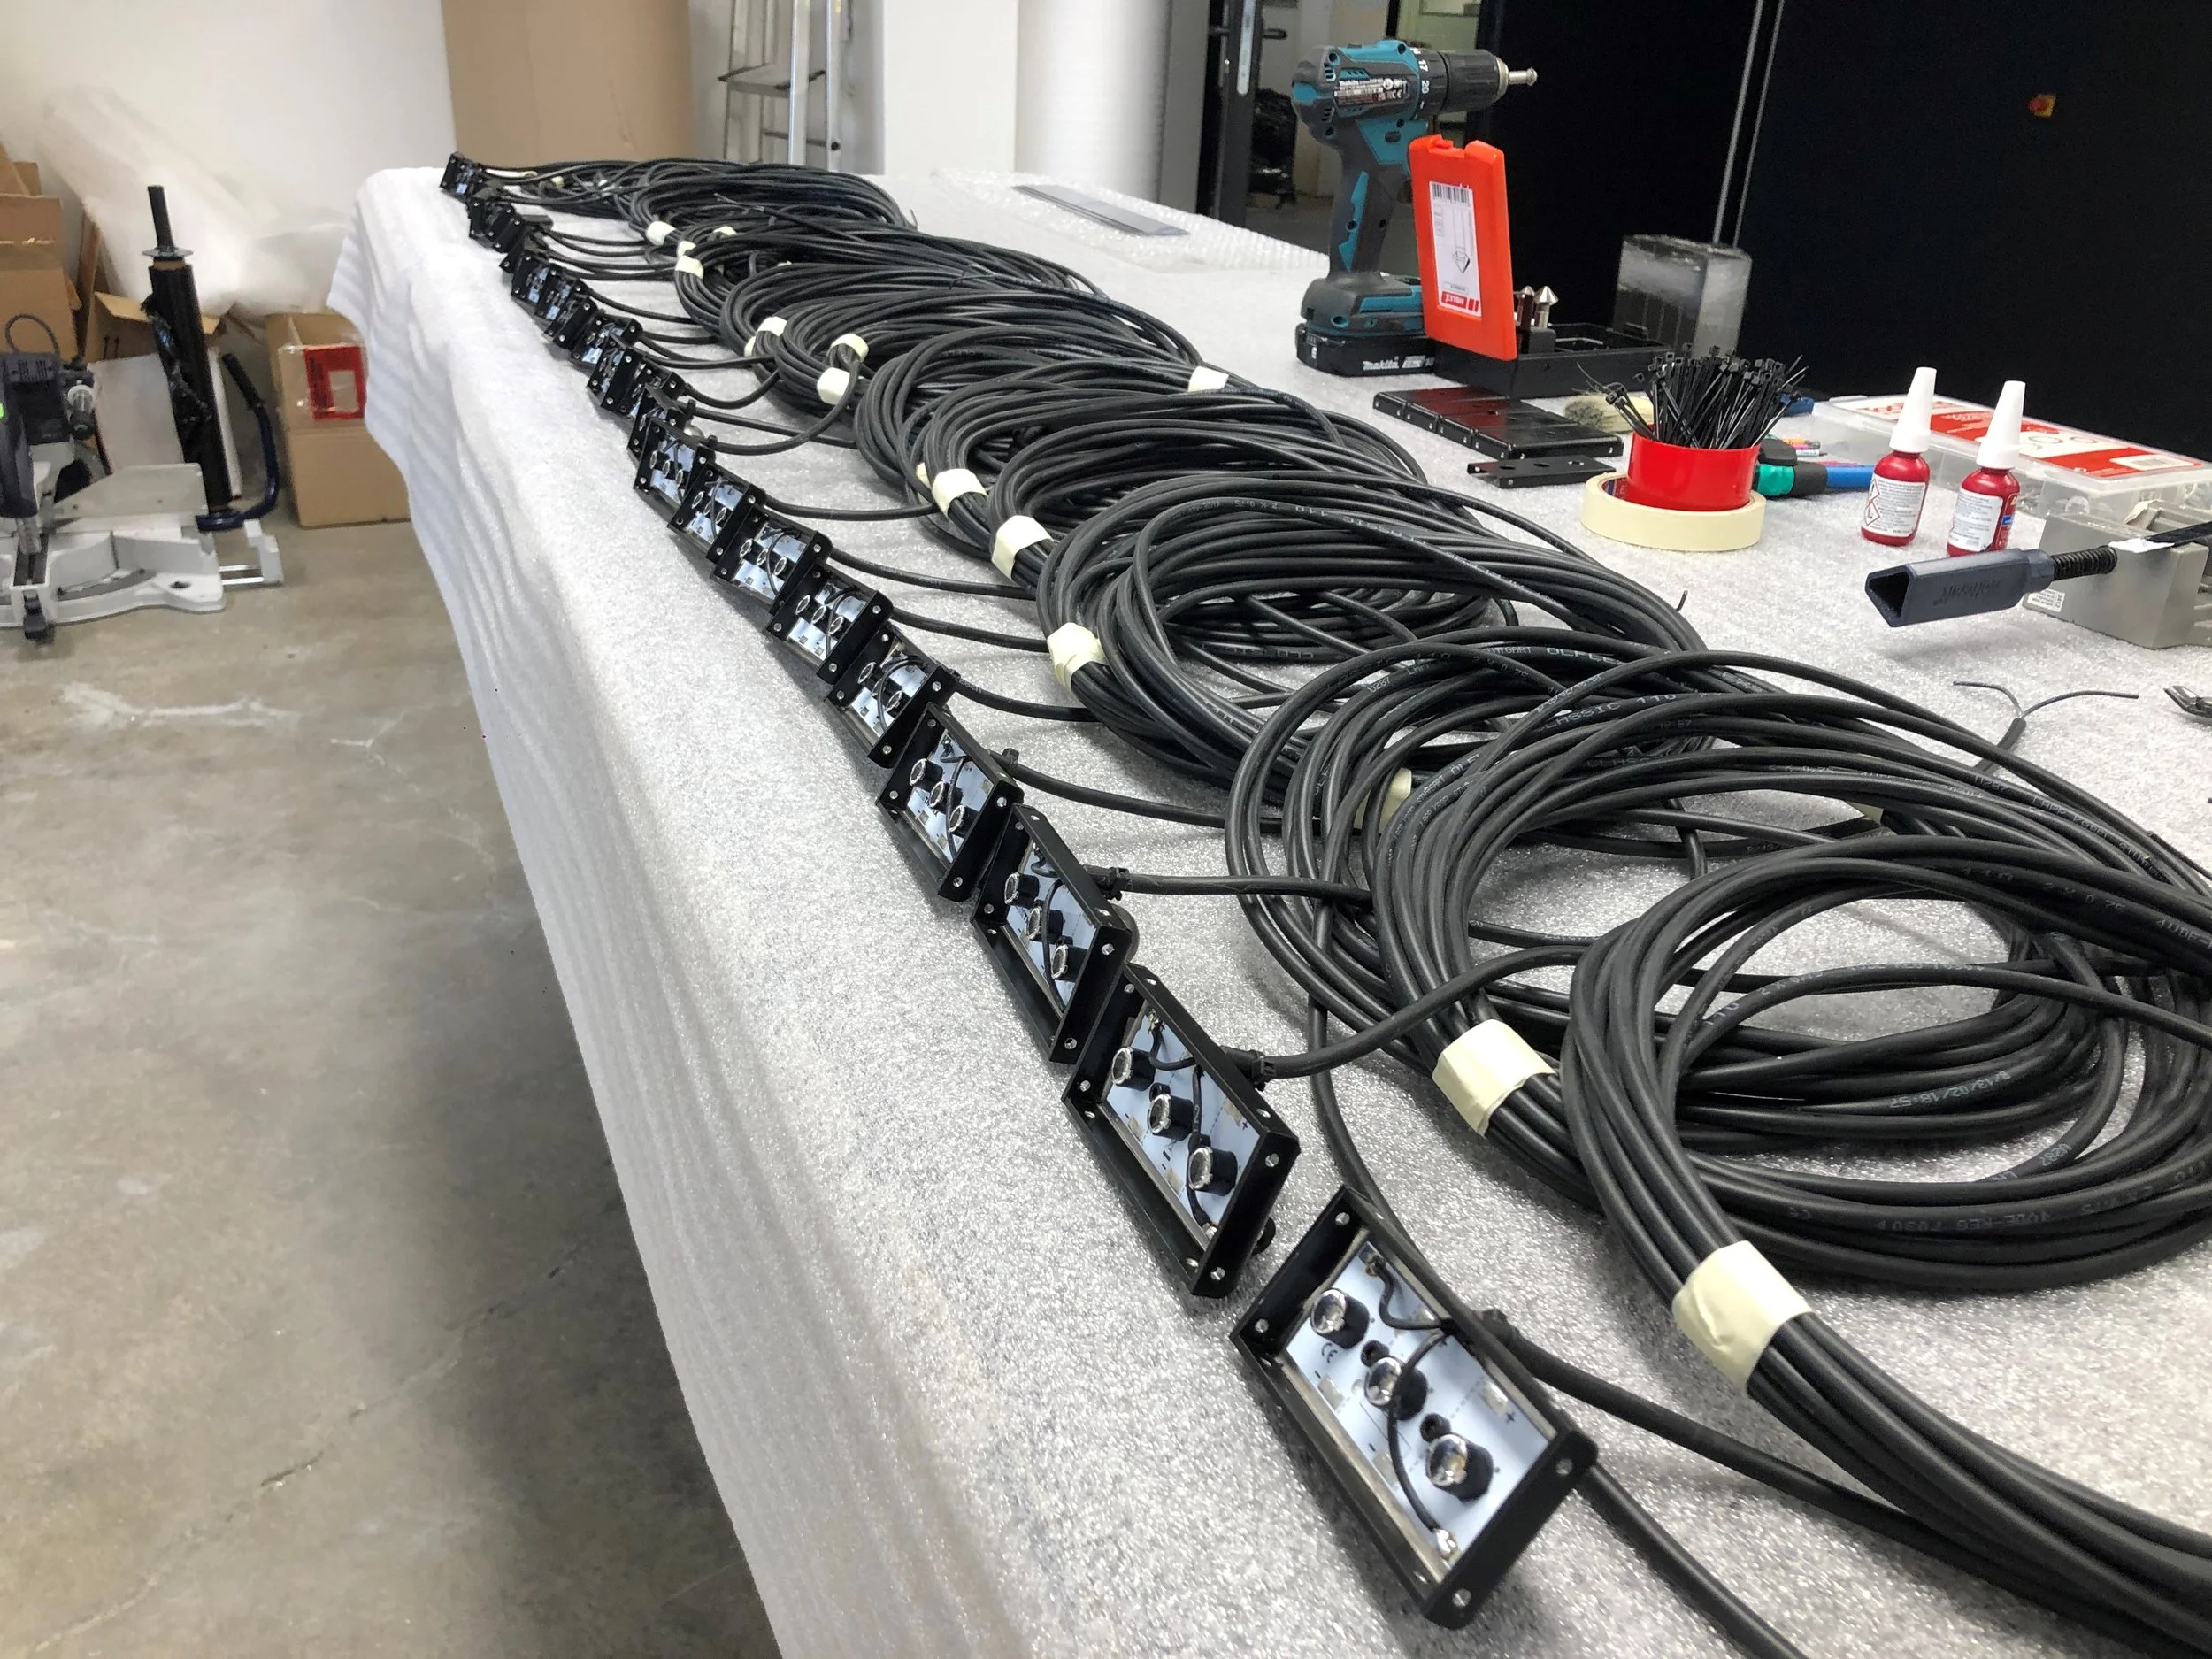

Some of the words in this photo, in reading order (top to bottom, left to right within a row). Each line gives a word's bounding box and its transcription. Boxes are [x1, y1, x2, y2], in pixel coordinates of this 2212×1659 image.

[1418, 59, 1429, 72] 17
[1421, 80, 1430, 94] 20
[1366, 676, 1391, 694] U287
[1635, 694, 1678, 705] 110
